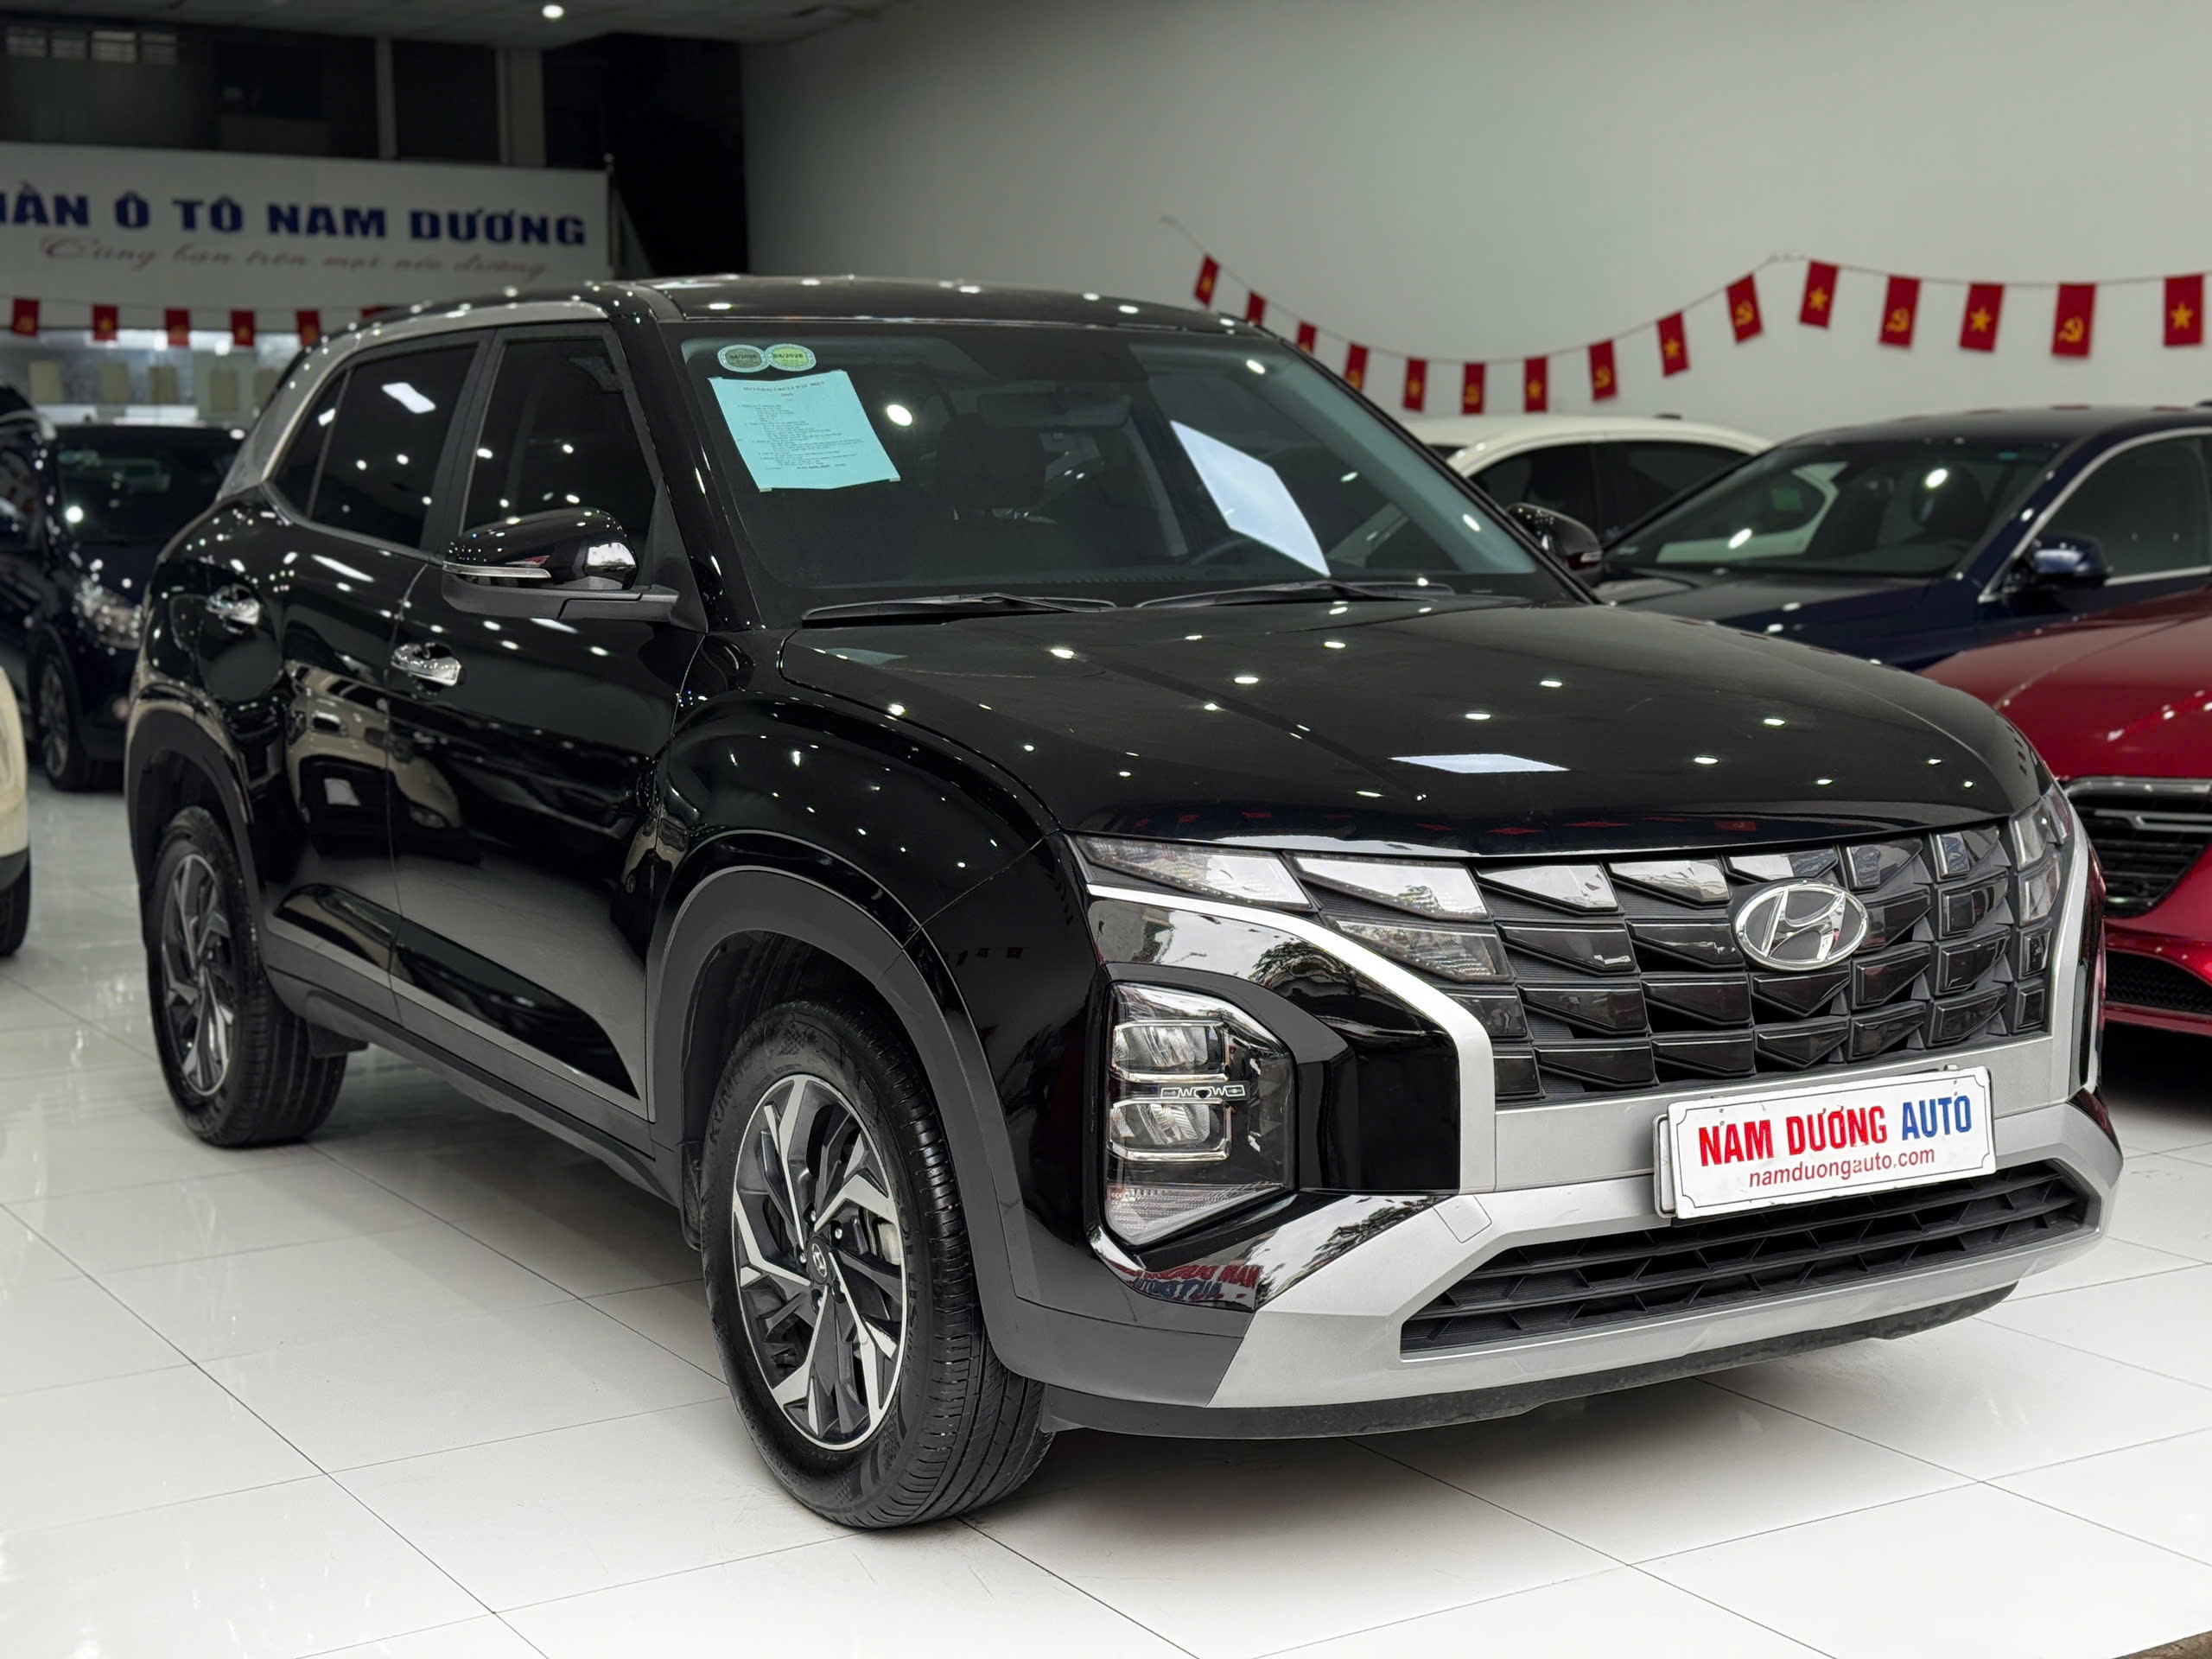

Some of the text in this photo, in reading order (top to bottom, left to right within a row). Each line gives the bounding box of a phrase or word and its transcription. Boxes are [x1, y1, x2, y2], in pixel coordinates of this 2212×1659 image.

[115, 191, 150, 230] Ô
[172, 196, 243, 233] TÔ
[267, 203, 387, 238] NAM
[409, 207, 585, 246] DƯƠNG
[1698, 1095, 1973, 1167] NAM DƯƠNG AUTO
[1749, 1147, 1936, 1188] namduongauto.com
